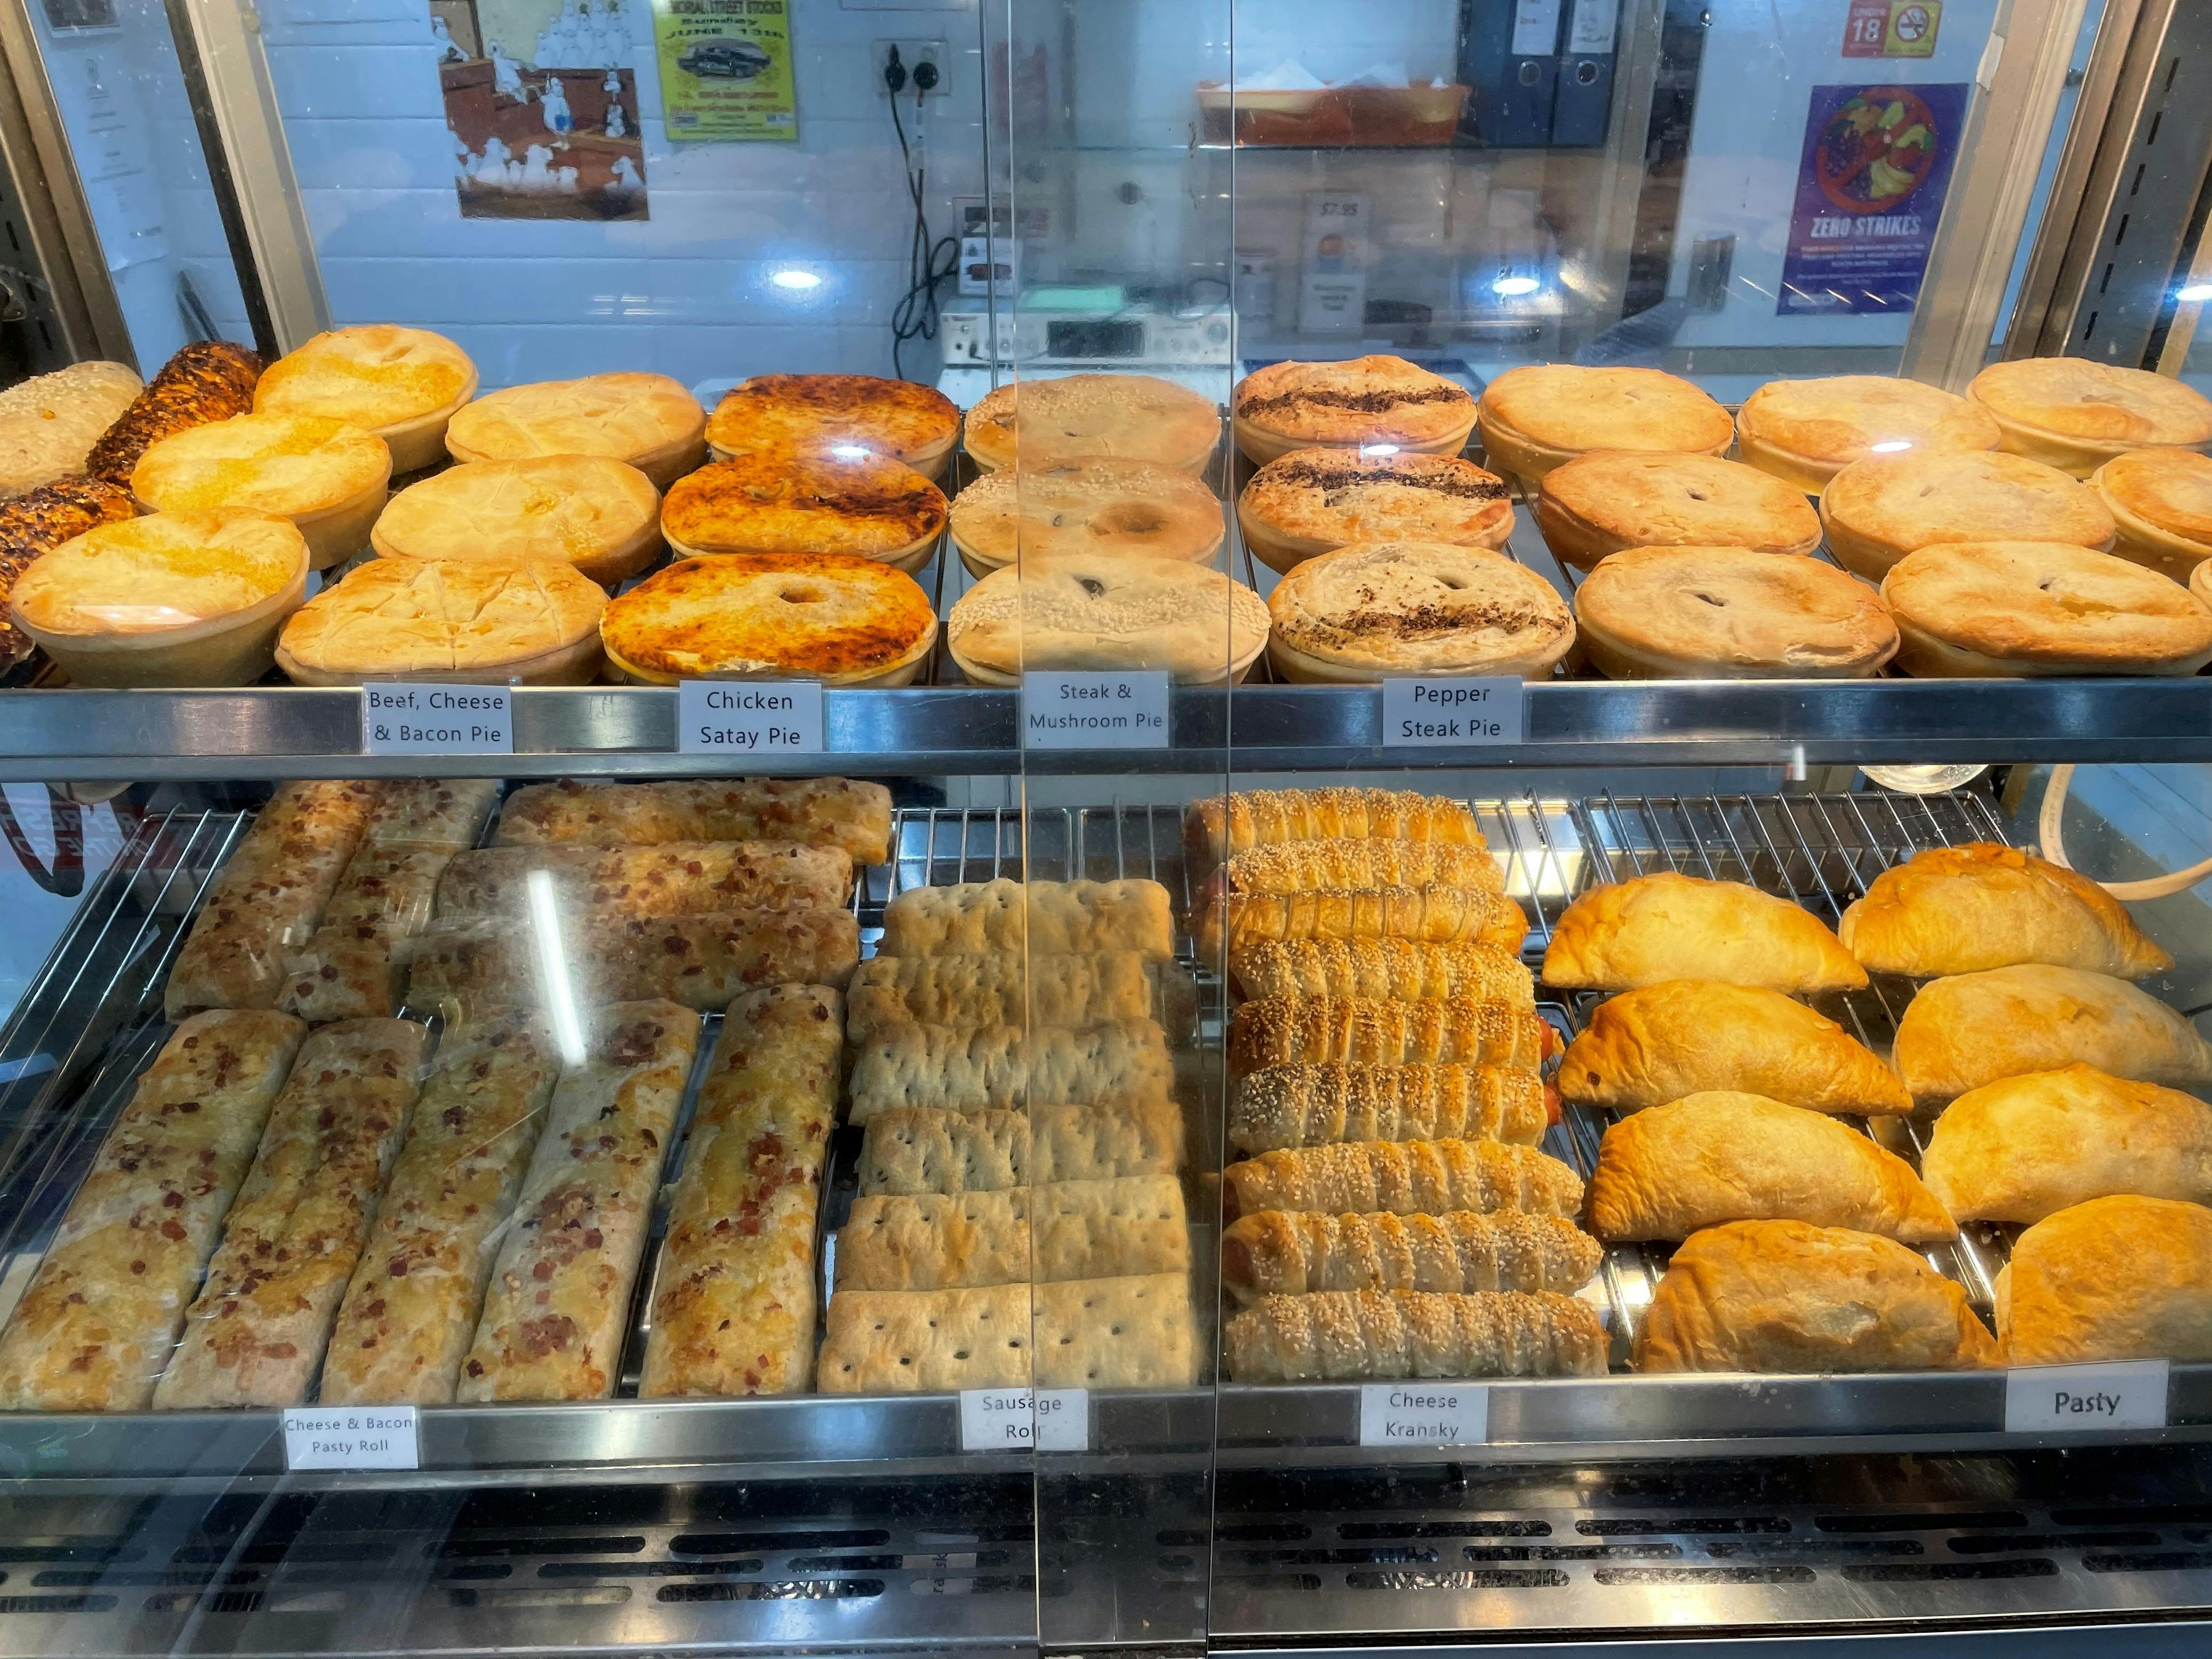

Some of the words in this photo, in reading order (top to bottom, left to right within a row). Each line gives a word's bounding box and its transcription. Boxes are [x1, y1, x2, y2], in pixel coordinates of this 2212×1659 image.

[1853, 18, 1882, 42] 18
[1811, 217, 1851, 238] ZERO
[1855, 215, 1921, 236] STRIKES
[707, 691, 793, 709] Chicken
[1060, 684, 1109, 699] Steak
[1117, 684, 1132, 699] &
[1414, 685, 1491, 707] Pepper
[370, 691, 420, 711] Beef,
[429, 692, 504, 709] Cheese
[1030, 713, 1127, 729] Mushroom
[1136, 713, 1163, 727] Pie
[1402, 719, 1460, 737] Steak
[1470, 719, 1500, 736] Pie
[374, 724, 391, 741] &
[400, 725, 461, 742] Bacon
[471, 725, 501, 742] Pie
[701, 726, 759, 749] Satay
[769, 727, 801, 744] Pie
[983, 1396, 1063, 1415] Sausage
[1390, 1392, 1458, 1408] Cheese
[2055, 1392, 2121, 1416] Pasty
[285, 1418, 341, 1431] Cheese
[347, 1418, 360, 1430] &
[366, 1417, 413, 1430] Bacon
[1006, 1422, 1041, 1440] Roll
[1385, 1421, 1459, 1440] Kransky
[312, 1441, 353, 1455] Pasty
[359, 1439, 389, 1452] Roll
